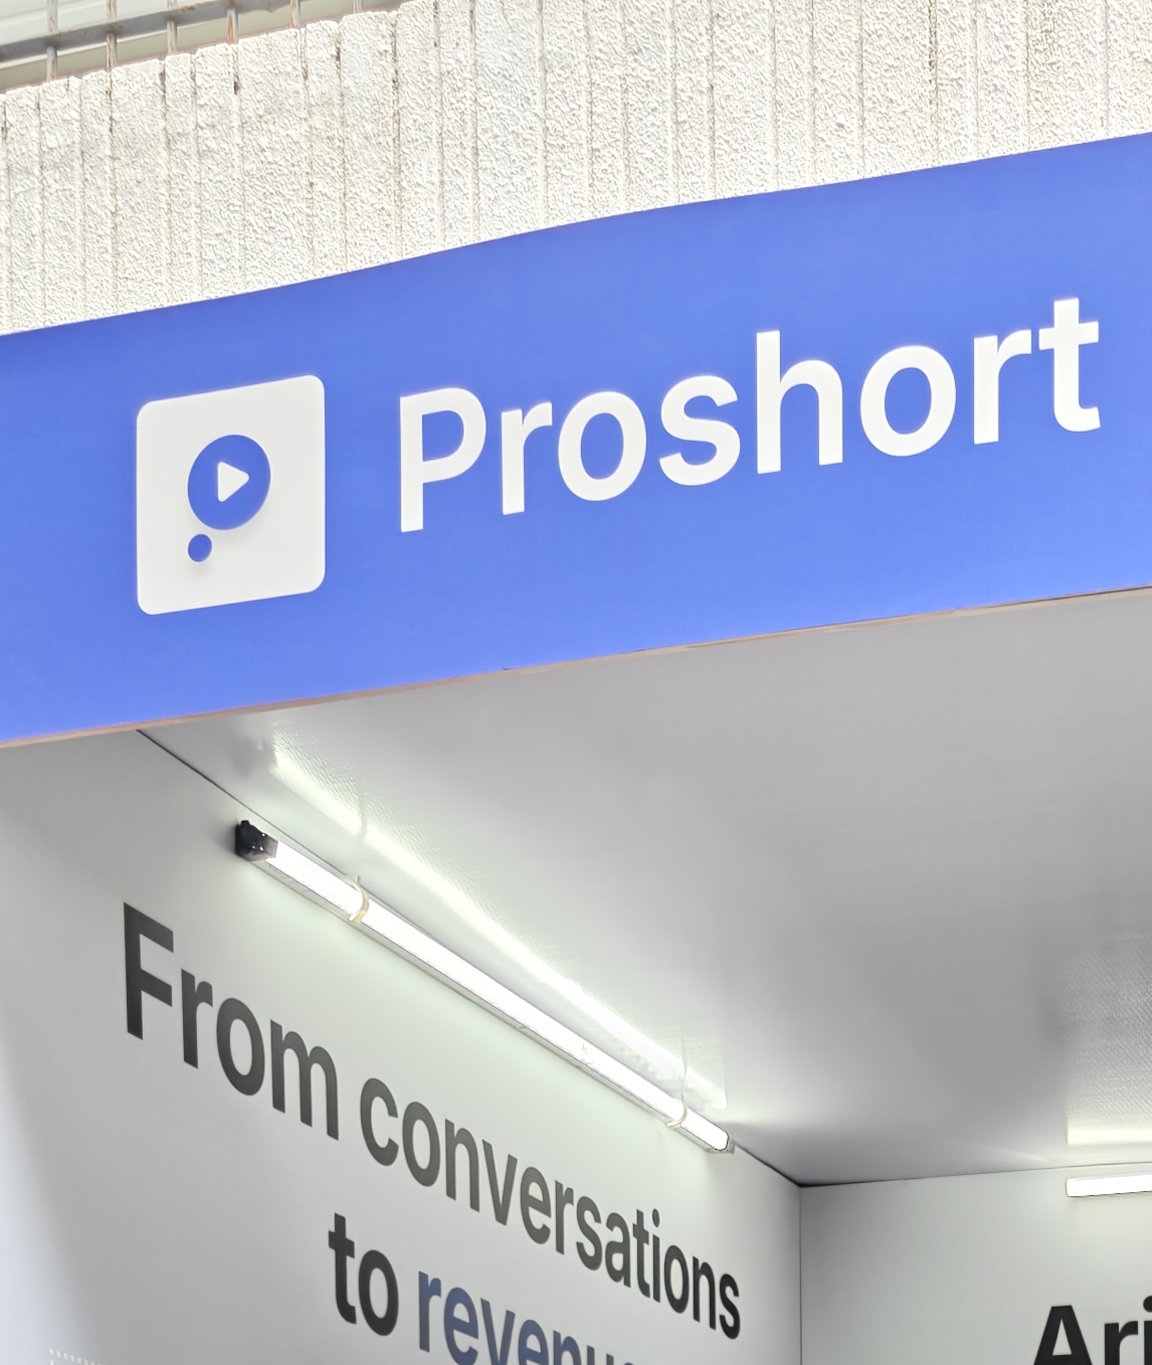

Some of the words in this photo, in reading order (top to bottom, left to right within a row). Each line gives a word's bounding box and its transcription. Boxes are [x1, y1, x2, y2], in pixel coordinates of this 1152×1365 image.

[400, 297, 1101, 532] Proshort
[123, 902, 340, 1141] From
[360, 1077, 741, 1340] conversations
[328, 1212, 399, 1337] to
